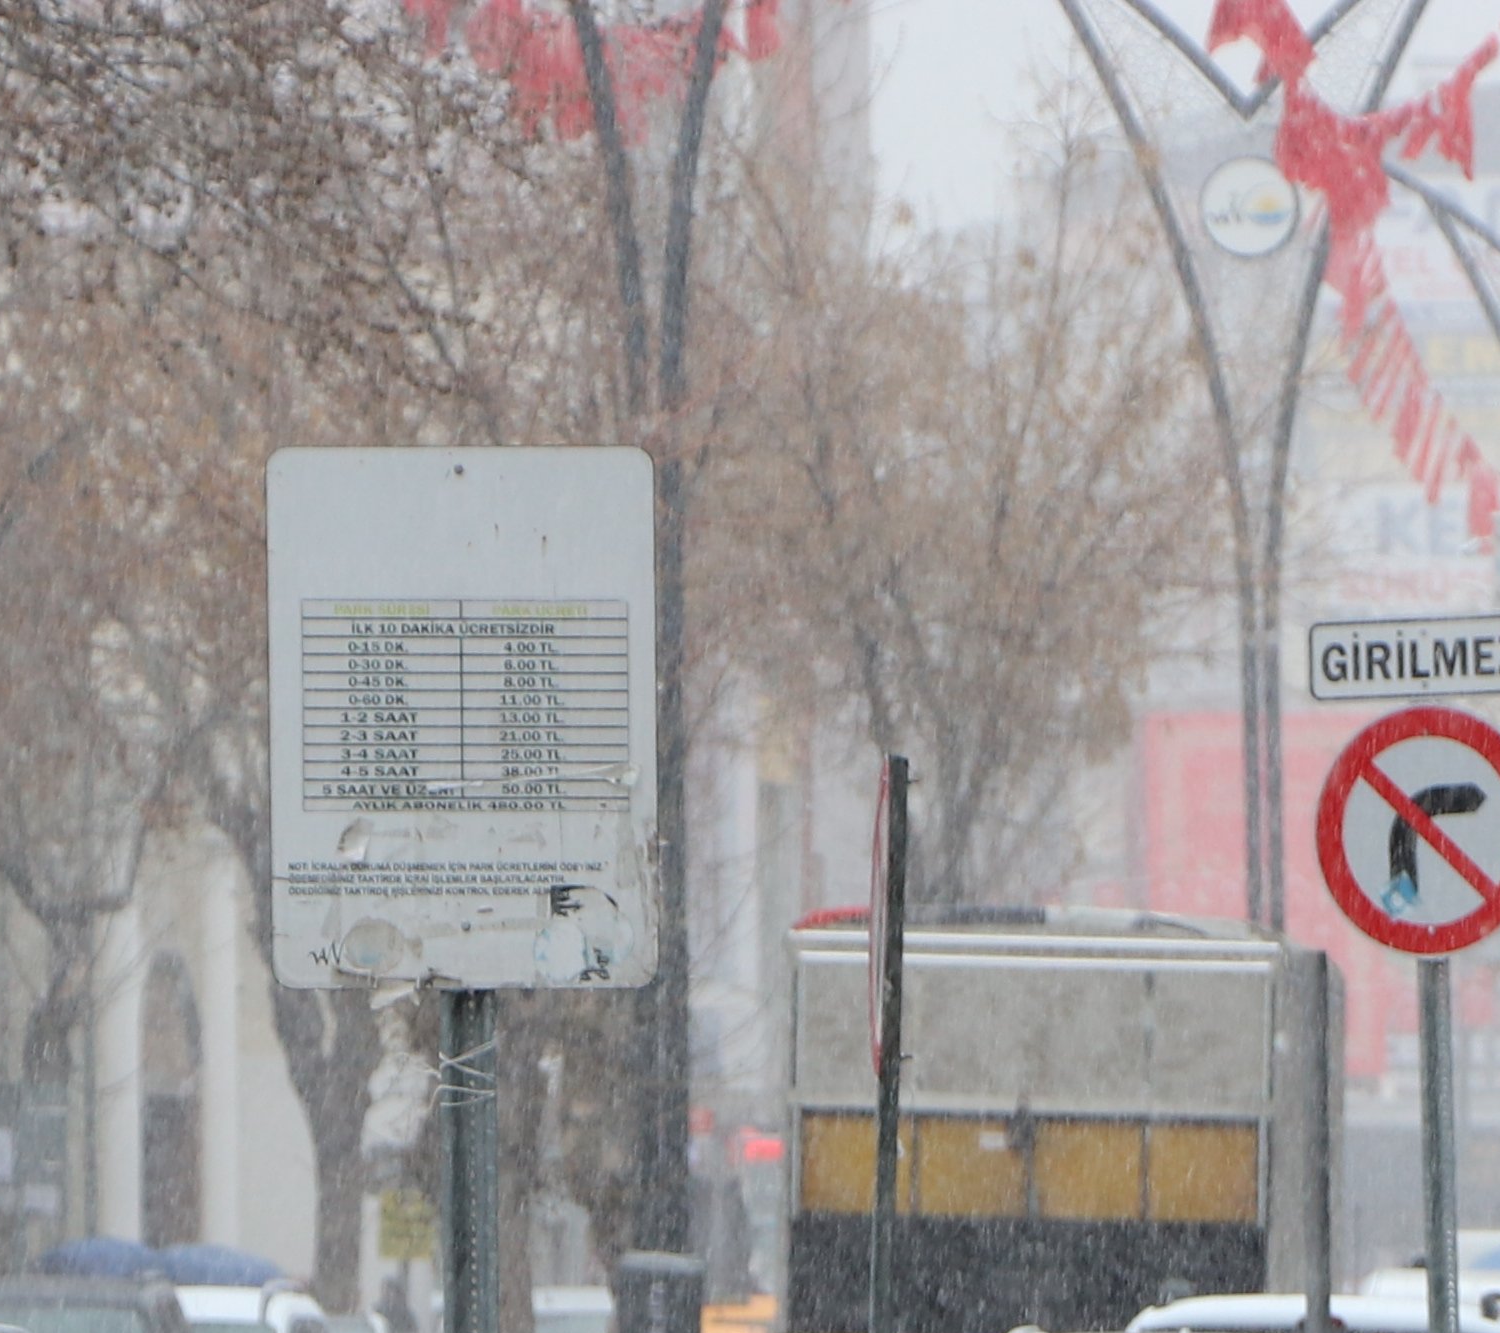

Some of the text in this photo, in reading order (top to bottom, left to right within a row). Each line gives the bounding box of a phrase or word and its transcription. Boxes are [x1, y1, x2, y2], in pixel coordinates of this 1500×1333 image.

[334, 605, 373, 616] PARK
[351, 620, 556, 635] İLK 10 DAKİKA ÜCRETSİZDİR
[347, 641, 560, 653] 0-15 DK. 4.00 TL.
[348, 659, 560, 671] 0-30 DK. 6.00 TL.
[348, 676, 560, 688] 0-45 DK. 8.00 TL.
[348, 694, 564, 706] 0-60 DK. 11.00 TL.
[340, 711, 565, 724] 1-2 SAAT 13.00 TL.
[340, 729, 565, 742] 2-3 SAAT 21.00 TL.
[340, 748, 566, 760] 3-4 SAAT 25.00 TL.
[341, 765, 370, 777] 4-5
[374, 765, 420, 777] SAAT
[502, 765, 542, 777] 38.00
[322, 783, 332, 795] 5
[337, 783, 376, 796] SAAT
[381, 783, 400, 796] VE
[501, 783, 543, 795] 50.00
[546, 783, 567, 795] TL.
[353, 799, 397, 811] AYLIK
[402, 799, 482, 811] ABONELİK
[469, 862, 493, 871] PARK
[492, 886, 530, 896] EDEREK
